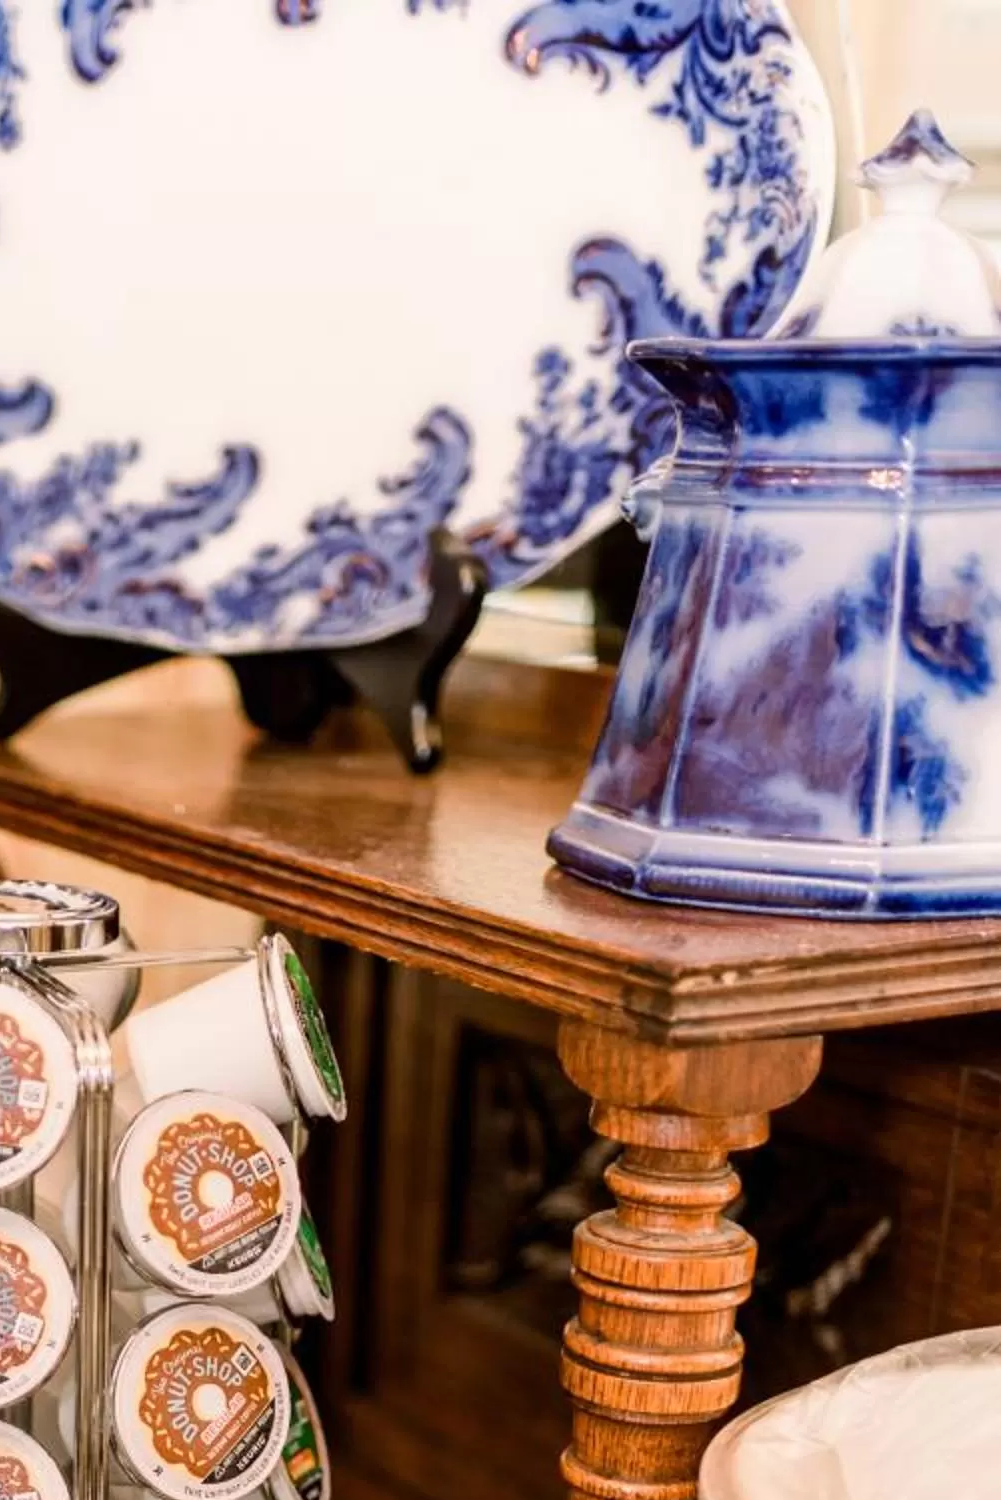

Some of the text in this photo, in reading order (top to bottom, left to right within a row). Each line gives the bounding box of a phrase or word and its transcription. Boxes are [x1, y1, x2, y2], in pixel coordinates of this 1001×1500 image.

[172, 1143, 254, 1222] DONUT SHOP
[167, 1357, 242, 1443] DONUT SHOP
[234, 1432, 270, 1471] KEURIG
